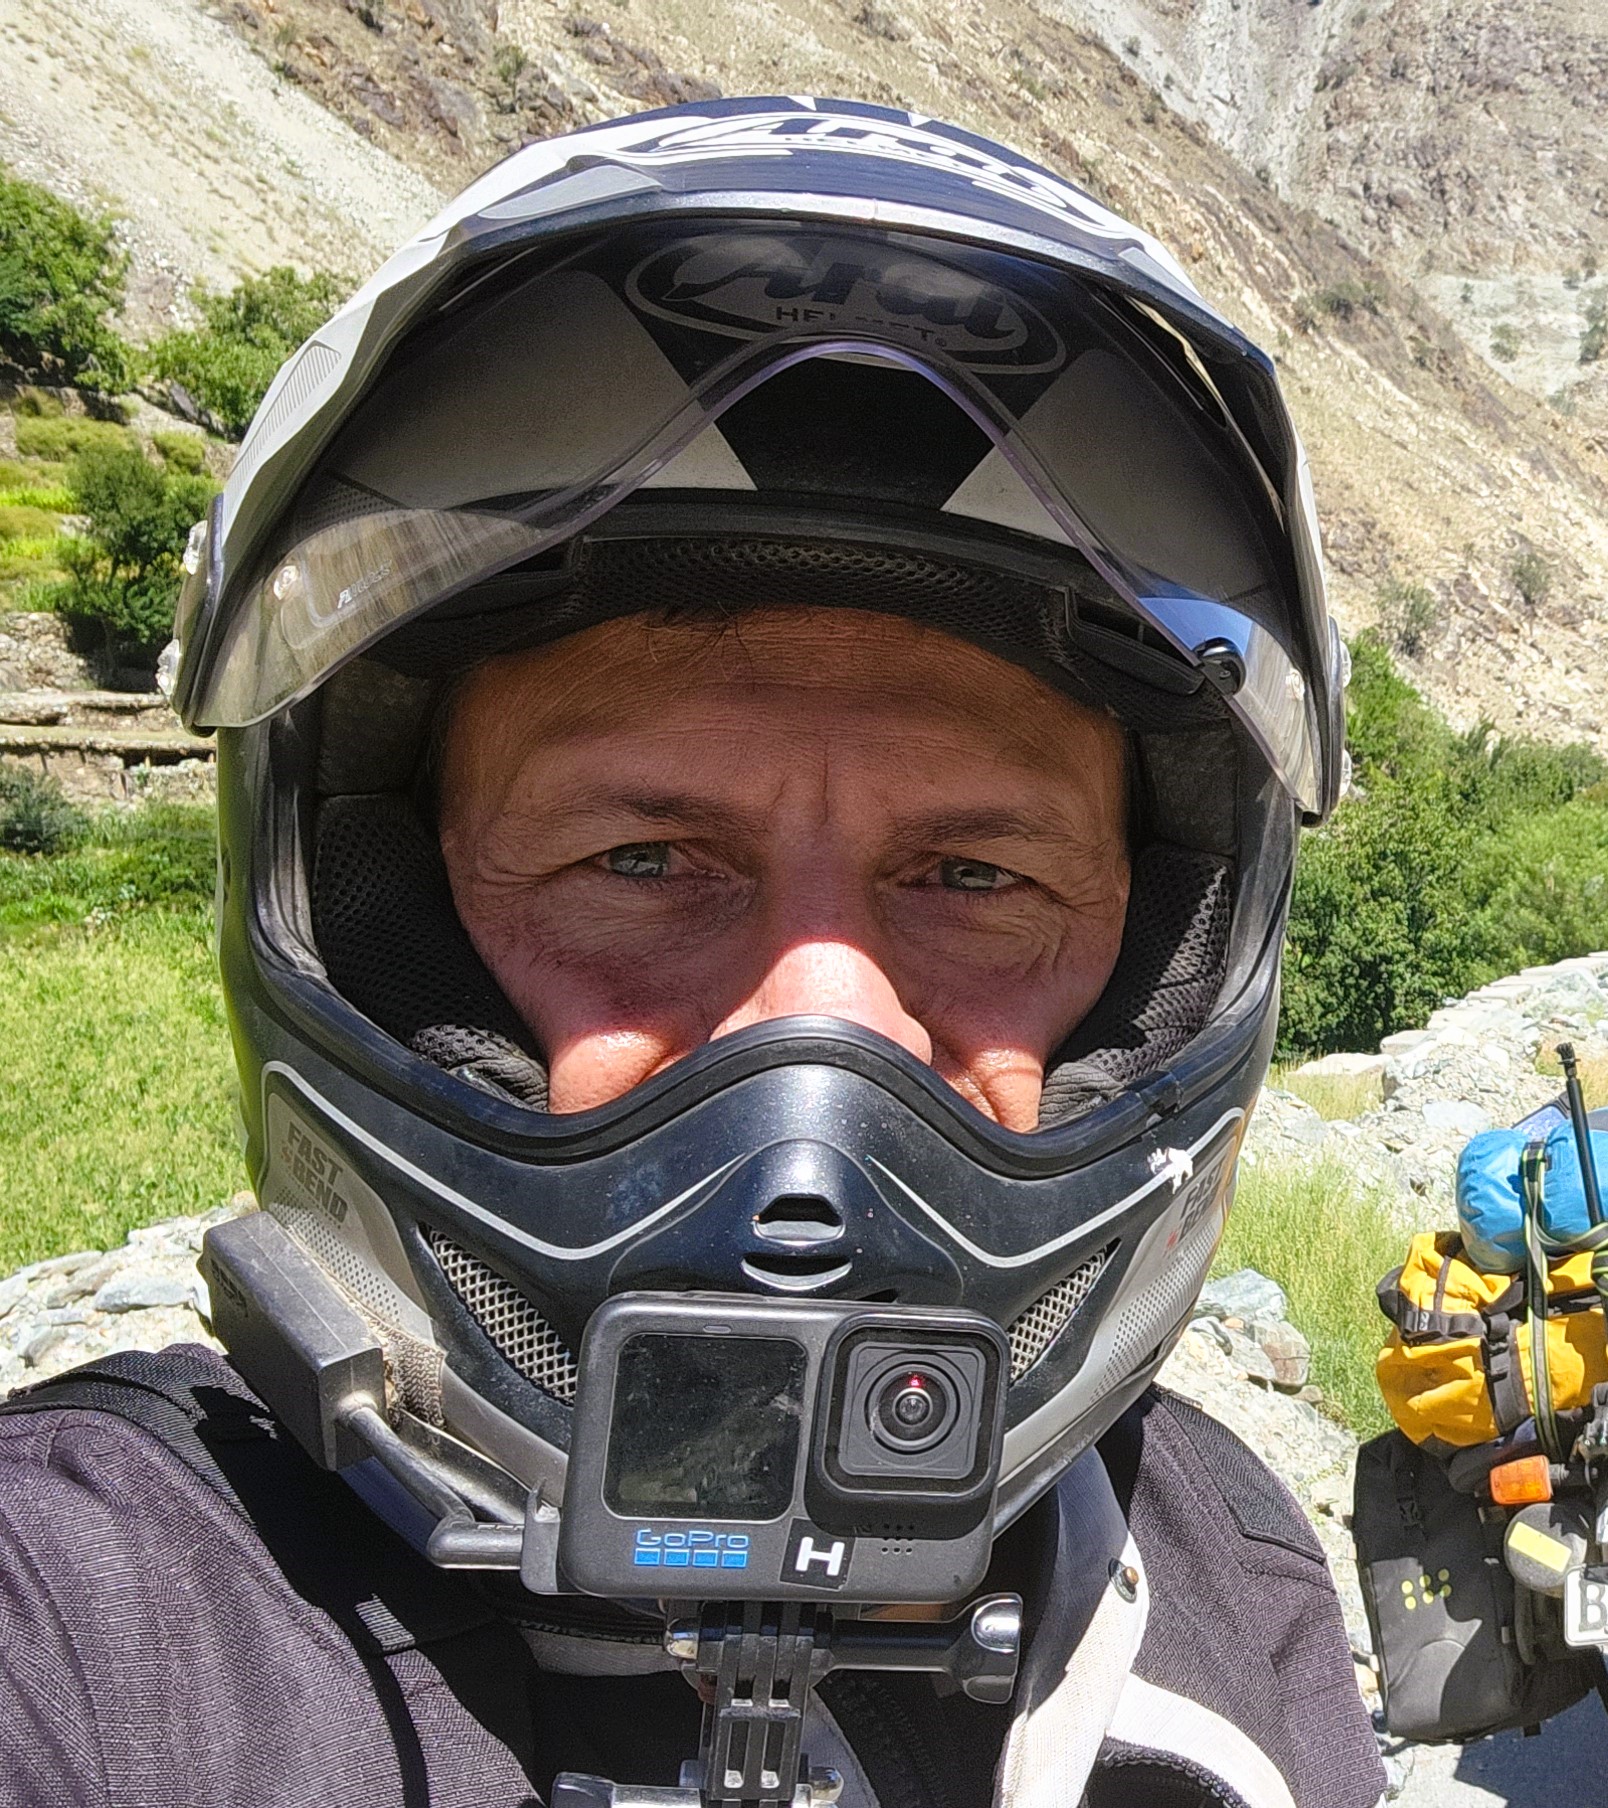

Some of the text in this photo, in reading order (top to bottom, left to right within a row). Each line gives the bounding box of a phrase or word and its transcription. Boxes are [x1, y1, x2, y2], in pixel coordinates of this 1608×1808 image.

[287, 1120, 344, 1186] FAST
[292, 1154, 349, 1224] BEND
[636, 1528, 749, 1549] GoPro
